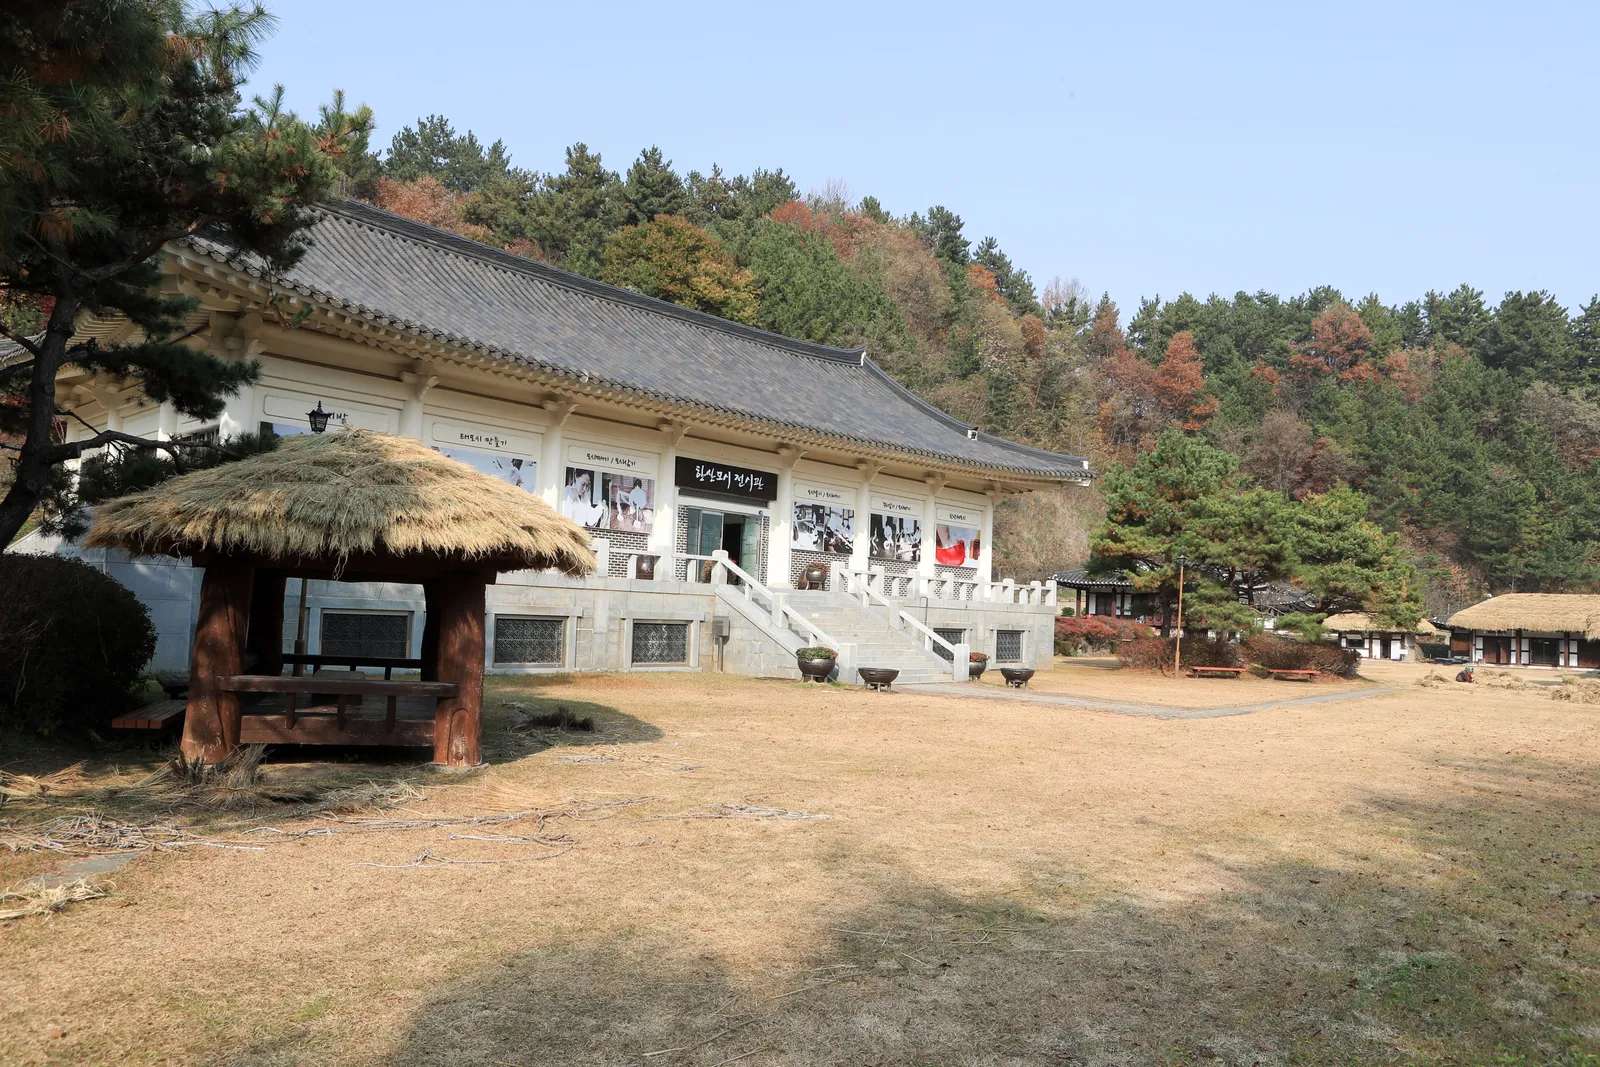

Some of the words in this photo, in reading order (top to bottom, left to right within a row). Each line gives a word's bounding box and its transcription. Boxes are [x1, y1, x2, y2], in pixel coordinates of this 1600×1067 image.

[460, 433, 482, 442] 태모시
[485, 436, 507, 448] 만들기
[695, 465, 731, 490] 한산모시
[733, 474, 765, 492] 전시관
